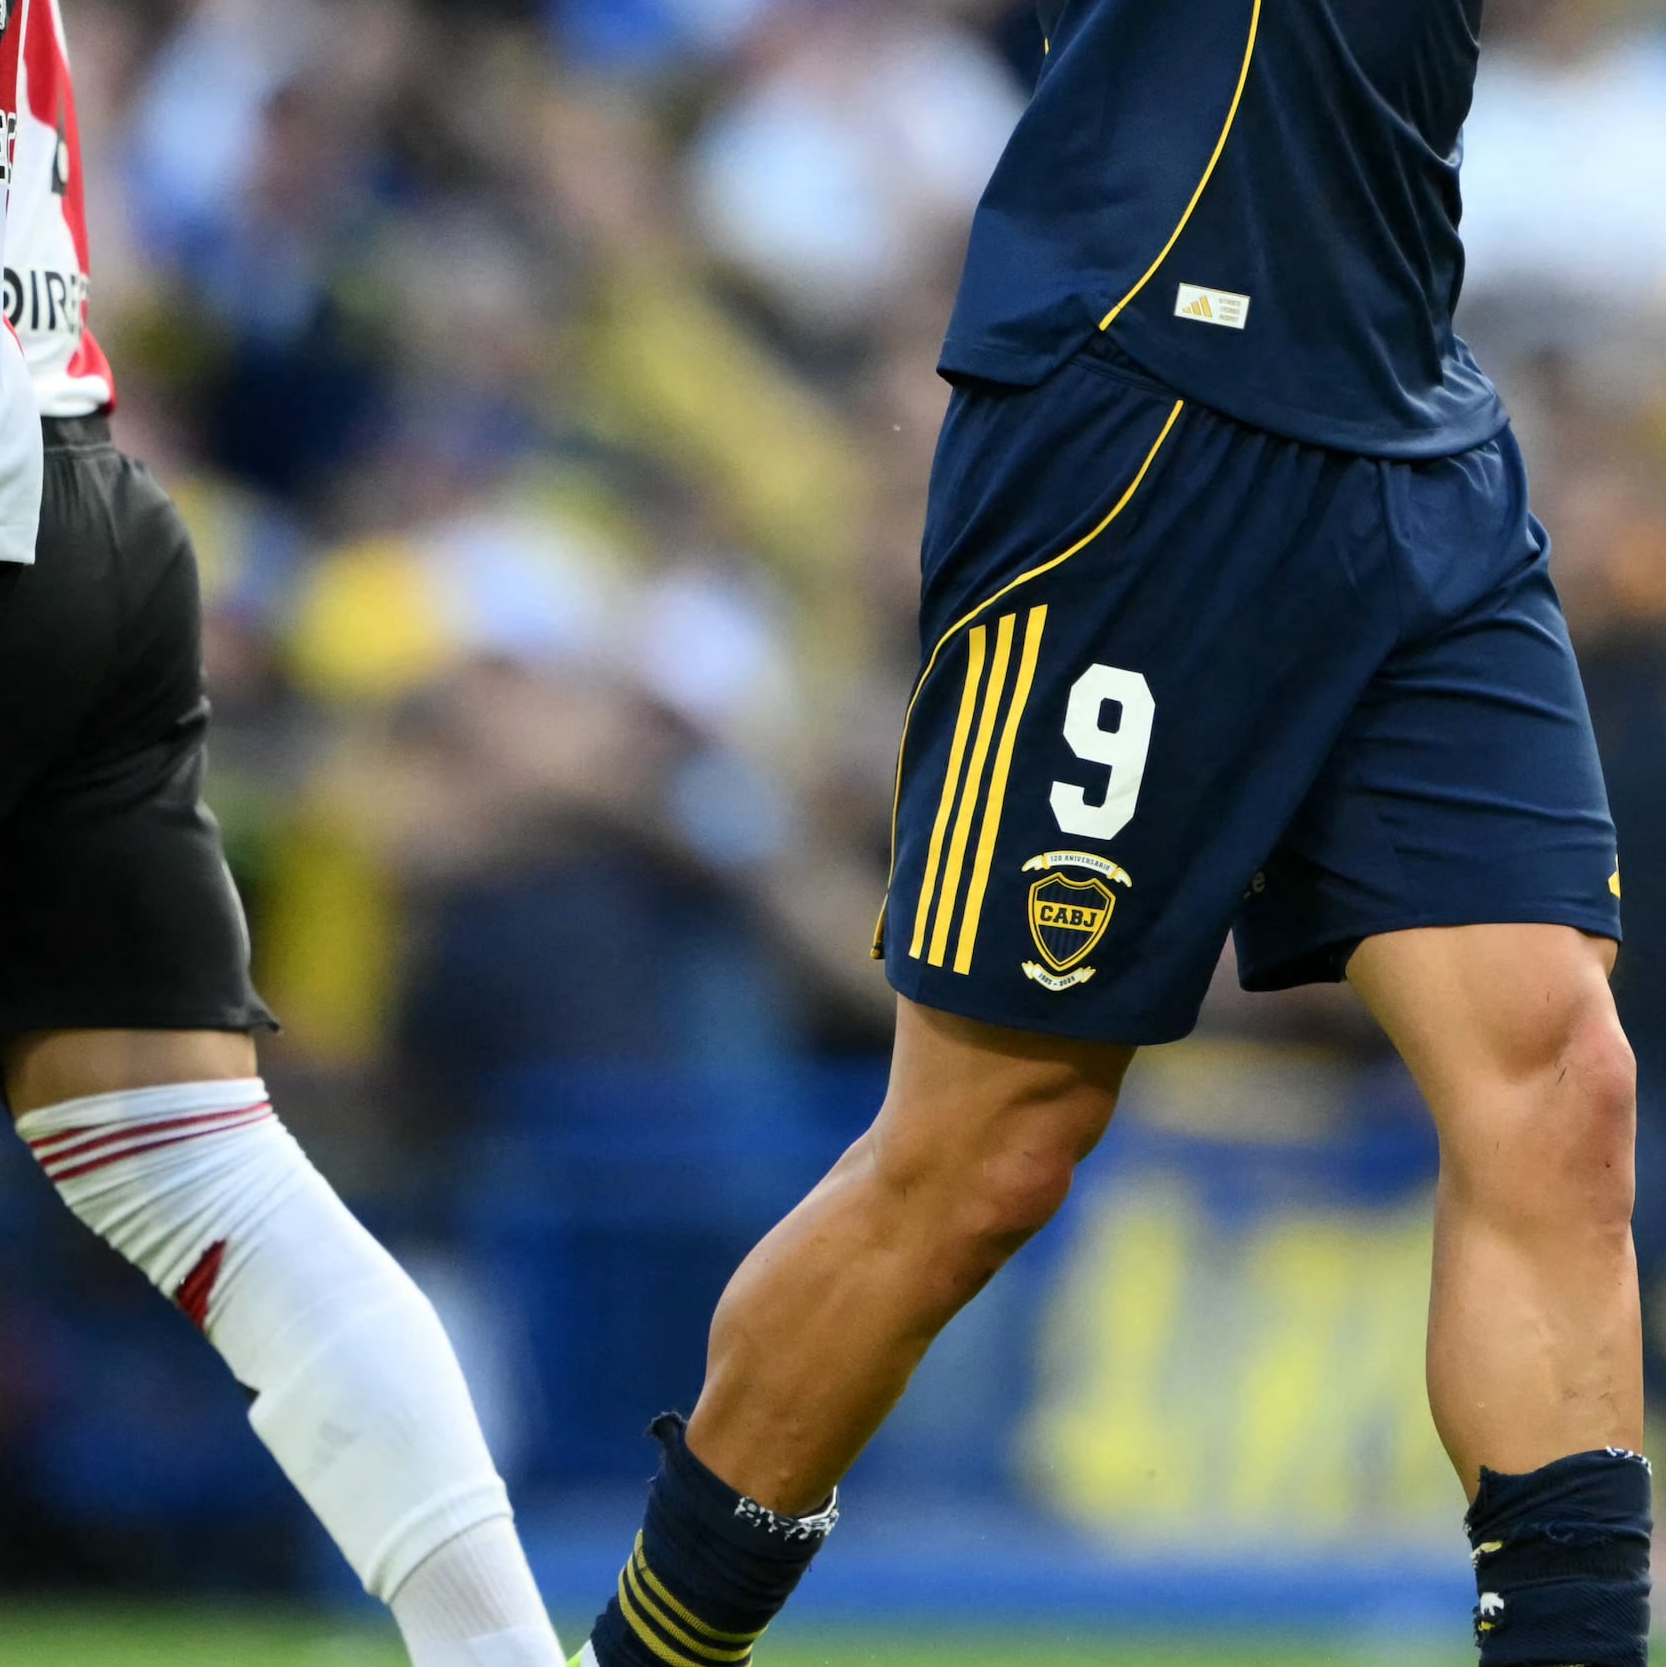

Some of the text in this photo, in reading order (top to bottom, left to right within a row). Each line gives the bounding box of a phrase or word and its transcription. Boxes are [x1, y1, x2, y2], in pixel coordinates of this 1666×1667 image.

[1049, 663, 1156, 841] 9
[1064, 855, 1111, 872] ANIVERSARIO
[1040, 905, 1098, 928] CABJ
